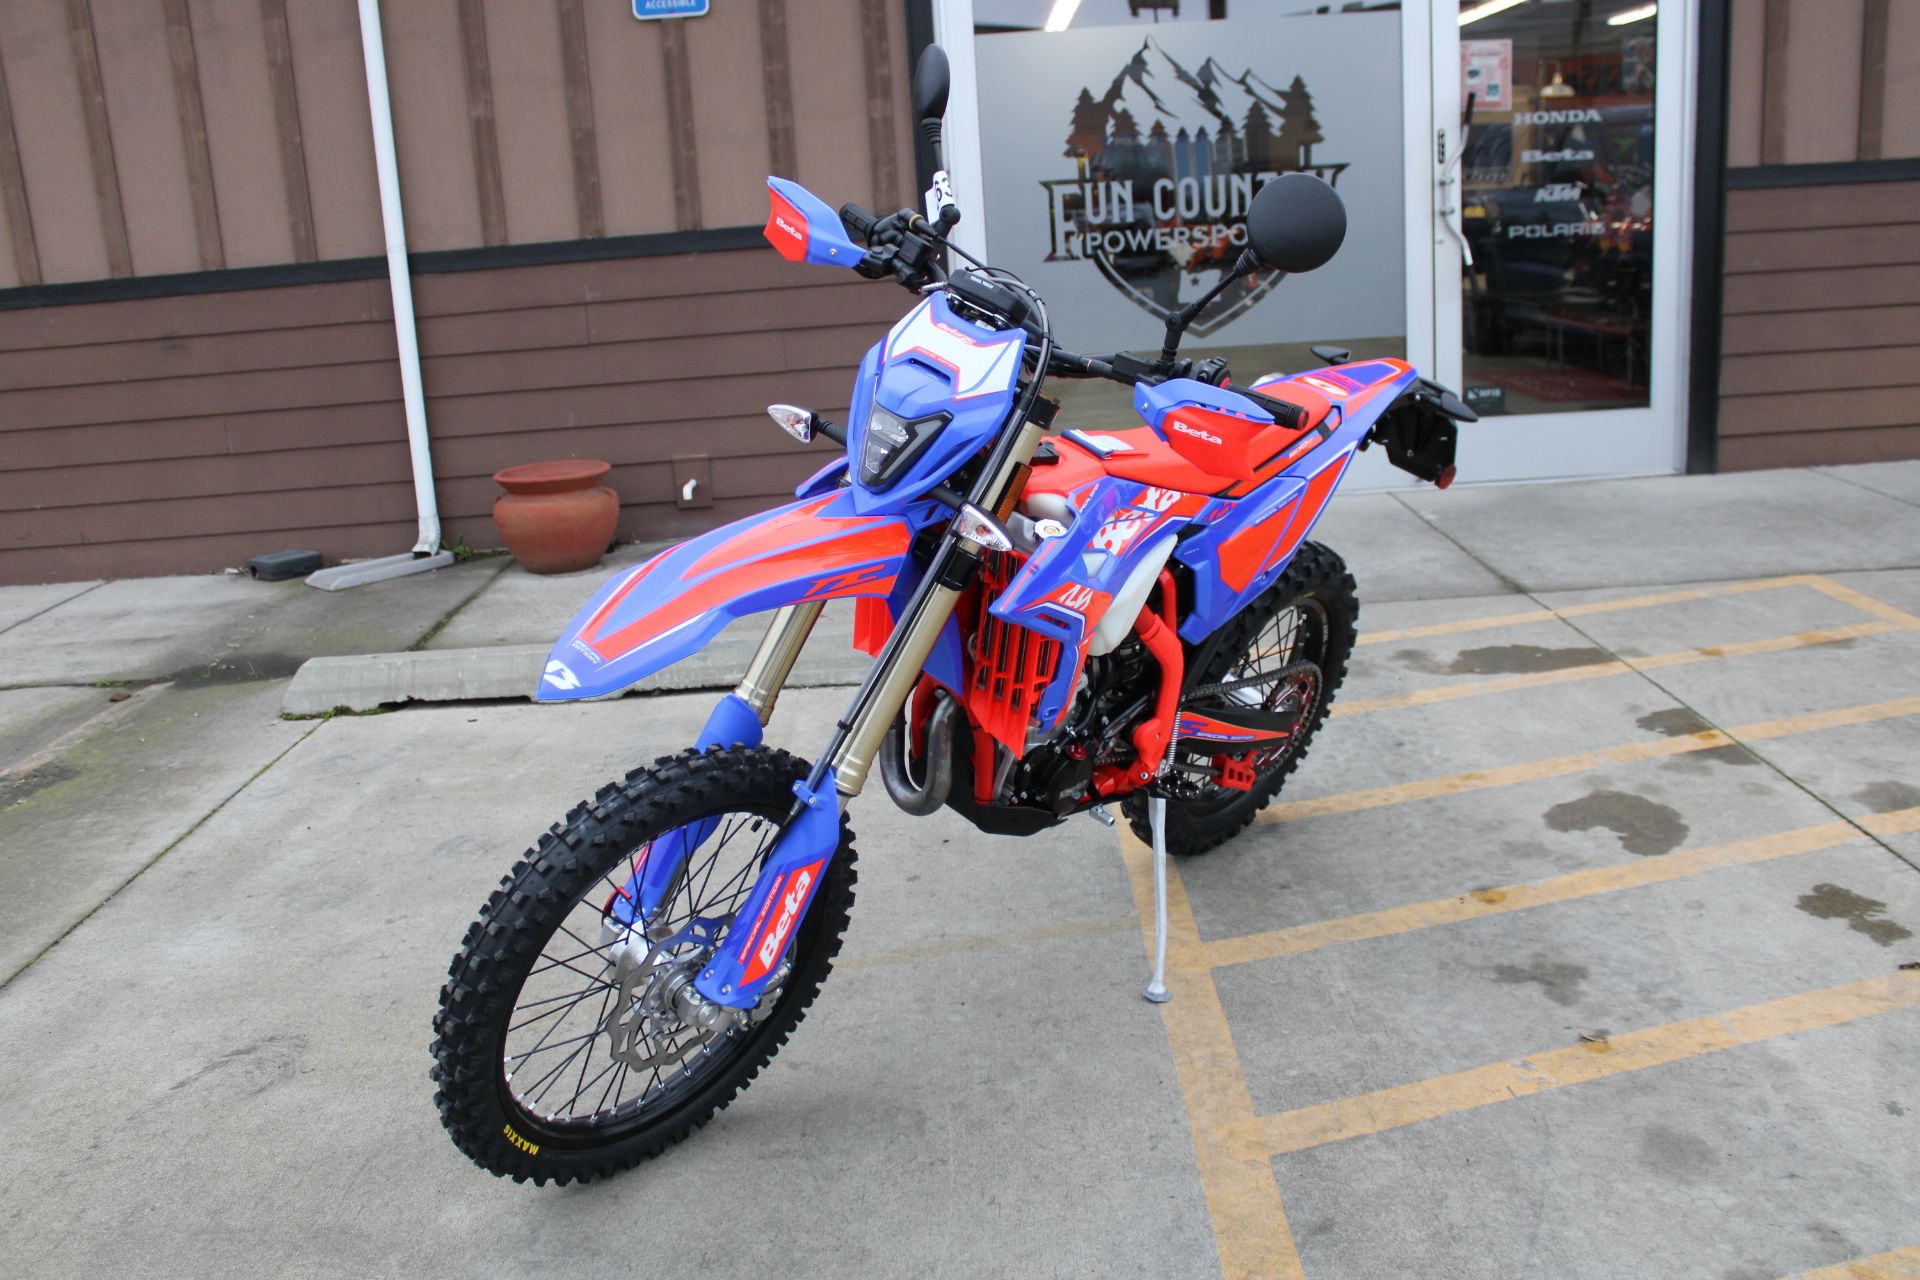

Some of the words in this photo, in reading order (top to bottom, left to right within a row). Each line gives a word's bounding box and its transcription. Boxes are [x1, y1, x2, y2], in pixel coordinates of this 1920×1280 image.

[1514, 109, 1602, 125] HONDA
[1521, 148, 1595, 163] Beta
[1534, 183, 1582, 202] KTM
[775, 216, 803, 241] Beta
[1048, 180, 1134, 259] FUN
[1508, 221, 1606, 239] POLARIS
[1086, 223, 1249, 252] POWERSPO
[1173, 420, 1223, 446] Beta
[739, 919, 763, 962] SPECIAL
[761, 874, 784, 917] EDITION
[759, 869, 812, 970] Beta
[503, 1124, 540, 1156] MAXXIS
